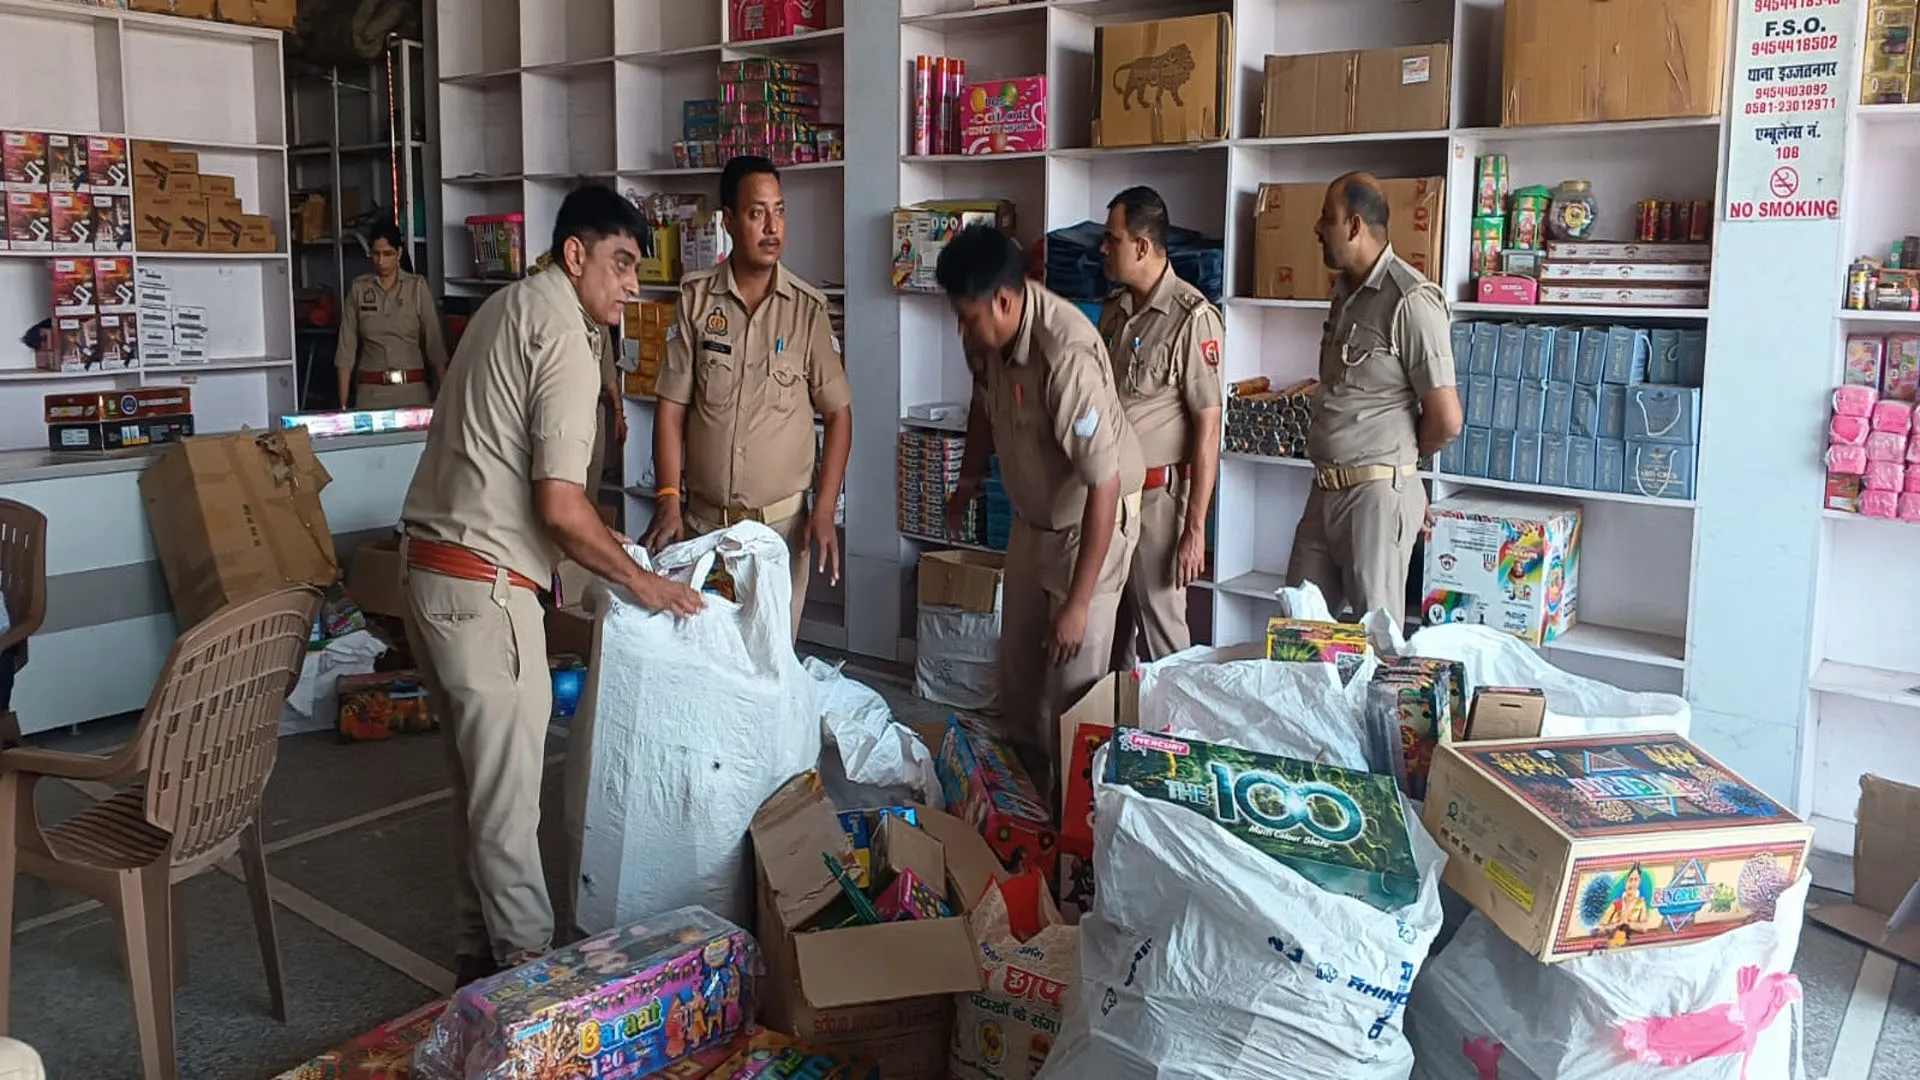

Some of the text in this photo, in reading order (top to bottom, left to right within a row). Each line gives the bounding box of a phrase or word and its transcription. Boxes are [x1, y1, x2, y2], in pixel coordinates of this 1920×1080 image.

[1765, 17, 1826, 37] F.S.O.
[1751, 35, 1838, 56] 9454418502
[1755, 83, 1828, 99] 9454403092
[1745, 97, 1836, 115] 0581-23012971
[1775, 146, 1800, 159] 108
[1730, 199, 1839, 218] NO SMOKING
[1134, 737, 1185, 752] MERCURY
[1165, 760, 1365, 844] THE 100
[579, 996, 663, 1058] Baraat
